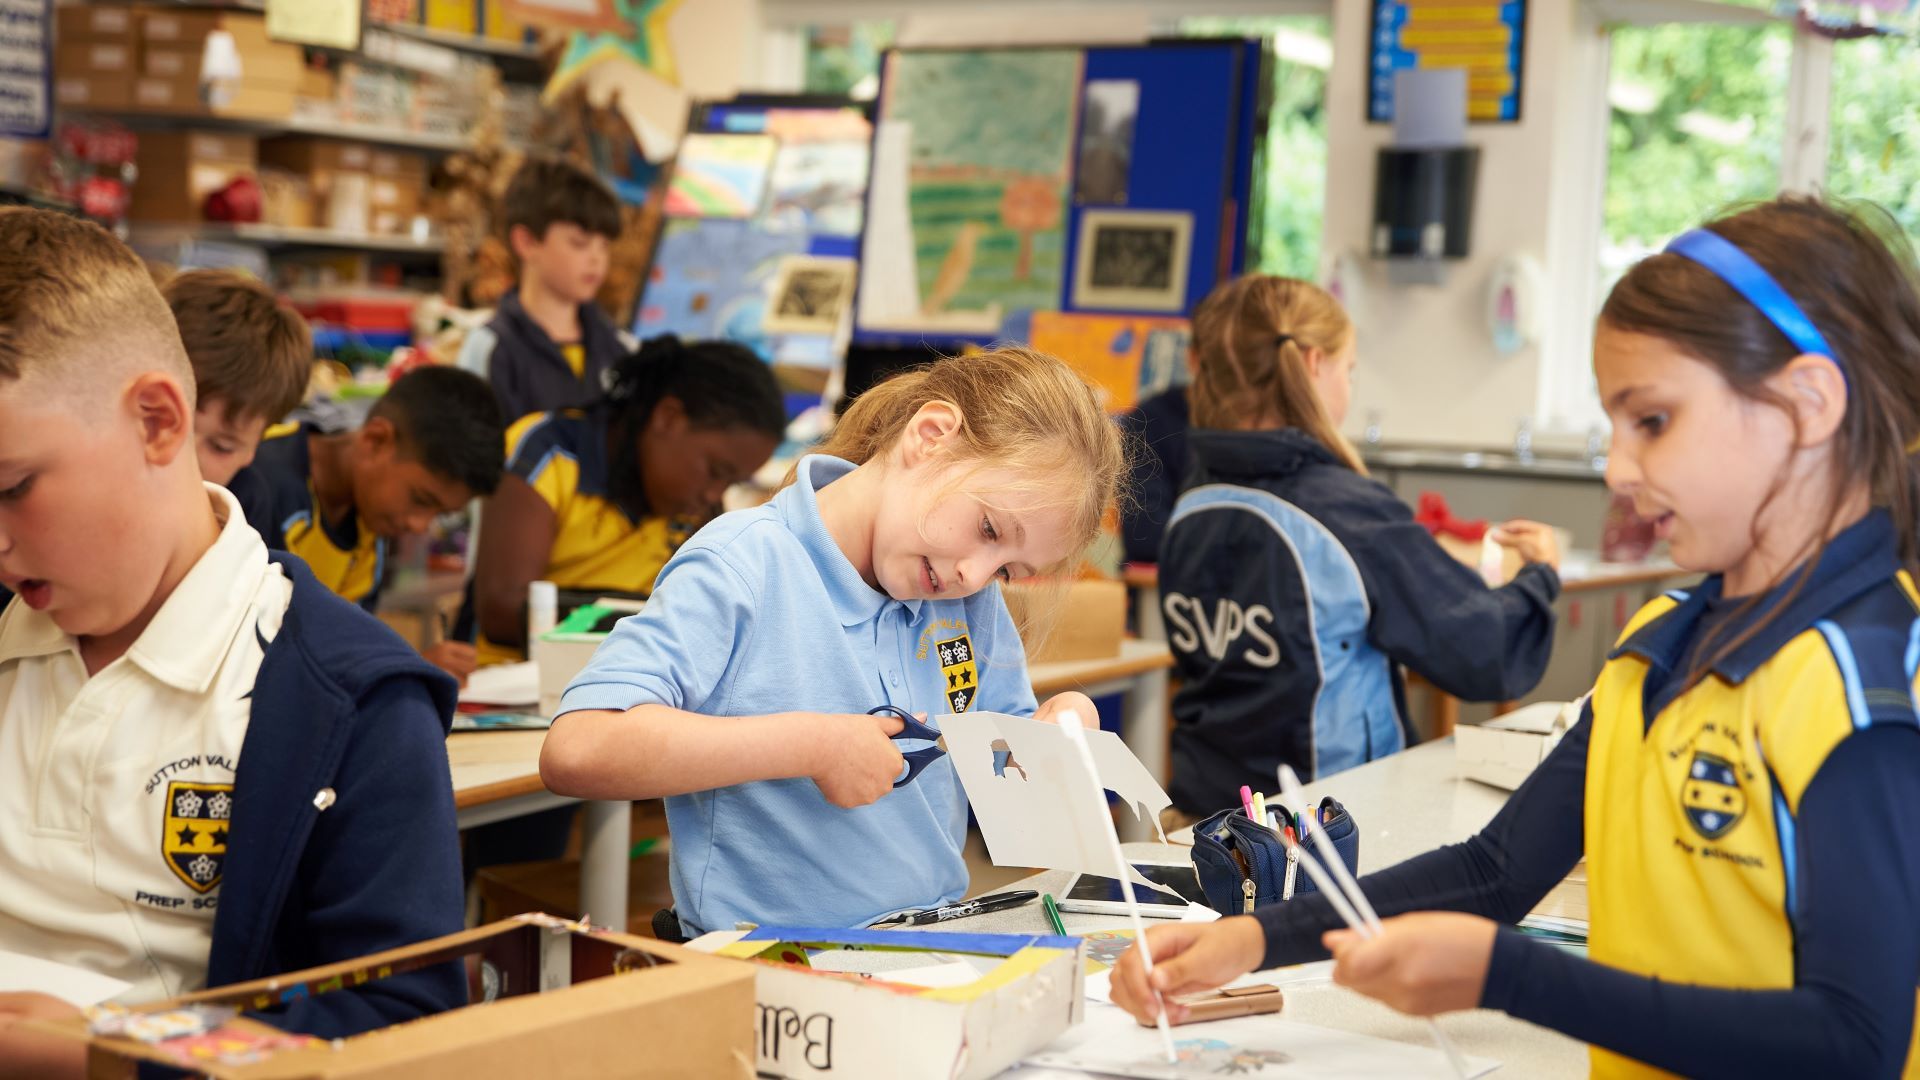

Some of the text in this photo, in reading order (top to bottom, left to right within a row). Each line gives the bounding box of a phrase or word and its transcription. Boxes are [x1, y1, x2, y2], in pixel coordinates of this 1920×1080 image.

[1164, 591, 1280, 668] SVPS
[145, 753, 237, 795] SUTTON VAL
[135, 889, 218, 909] PREP SC
[756, 1002, 834, 1071] Bell
